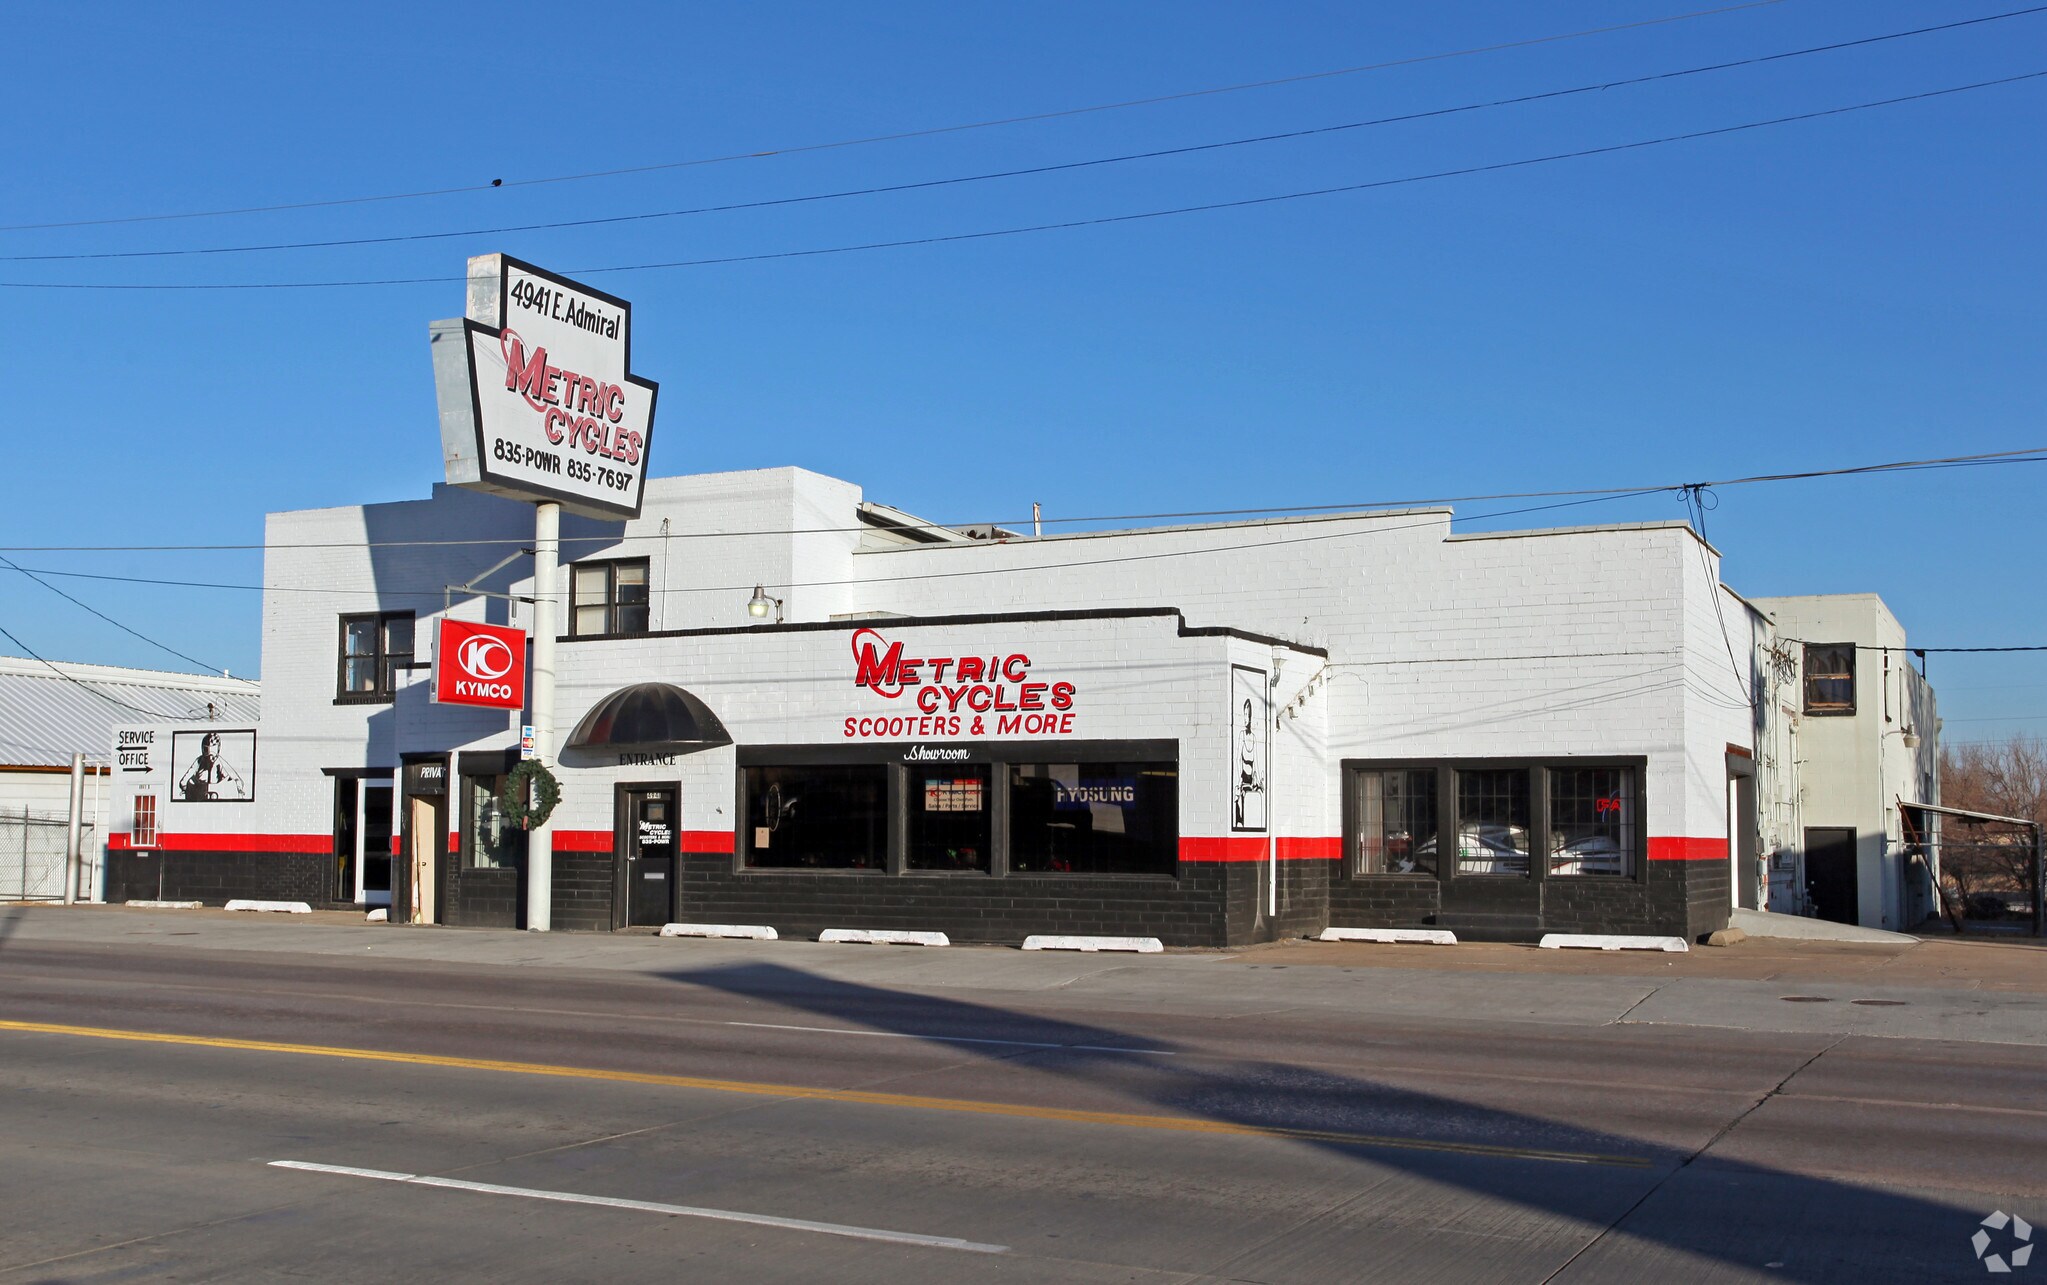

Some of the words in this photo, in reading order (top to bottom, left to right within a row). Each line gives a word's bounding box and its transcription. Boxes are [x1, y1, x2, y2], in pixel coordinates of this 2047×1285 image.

[511, 278, 550, 317] 4941
[505, 337, 625, 424] METRIC
[544, 408, 643, 466] CYCLES
[493, 437, 561, 475] 835-POWR
[567, 458, 633, 492] 835-7697
[854, 640, 1031, 687] METRIC
[455, 680, 512, 700] KYMCO
[917, 681, 1077, 715] CYCLES
[843, 715, 962, 738] SCOOTERS
[969, 714, 986, 736] &
[996, 713, 1077, 735] MORE
[118, 730, 155, 744] SERVICE
[118, 752, 149, 766] OFFICE
[619, 752, 677, 766] ENTRANCE
[903, 744, 971, 761] Showroom
[420, 766, 447, 779] PRIVAT
[1057, 786, 1134, 803] HYOSUNG
